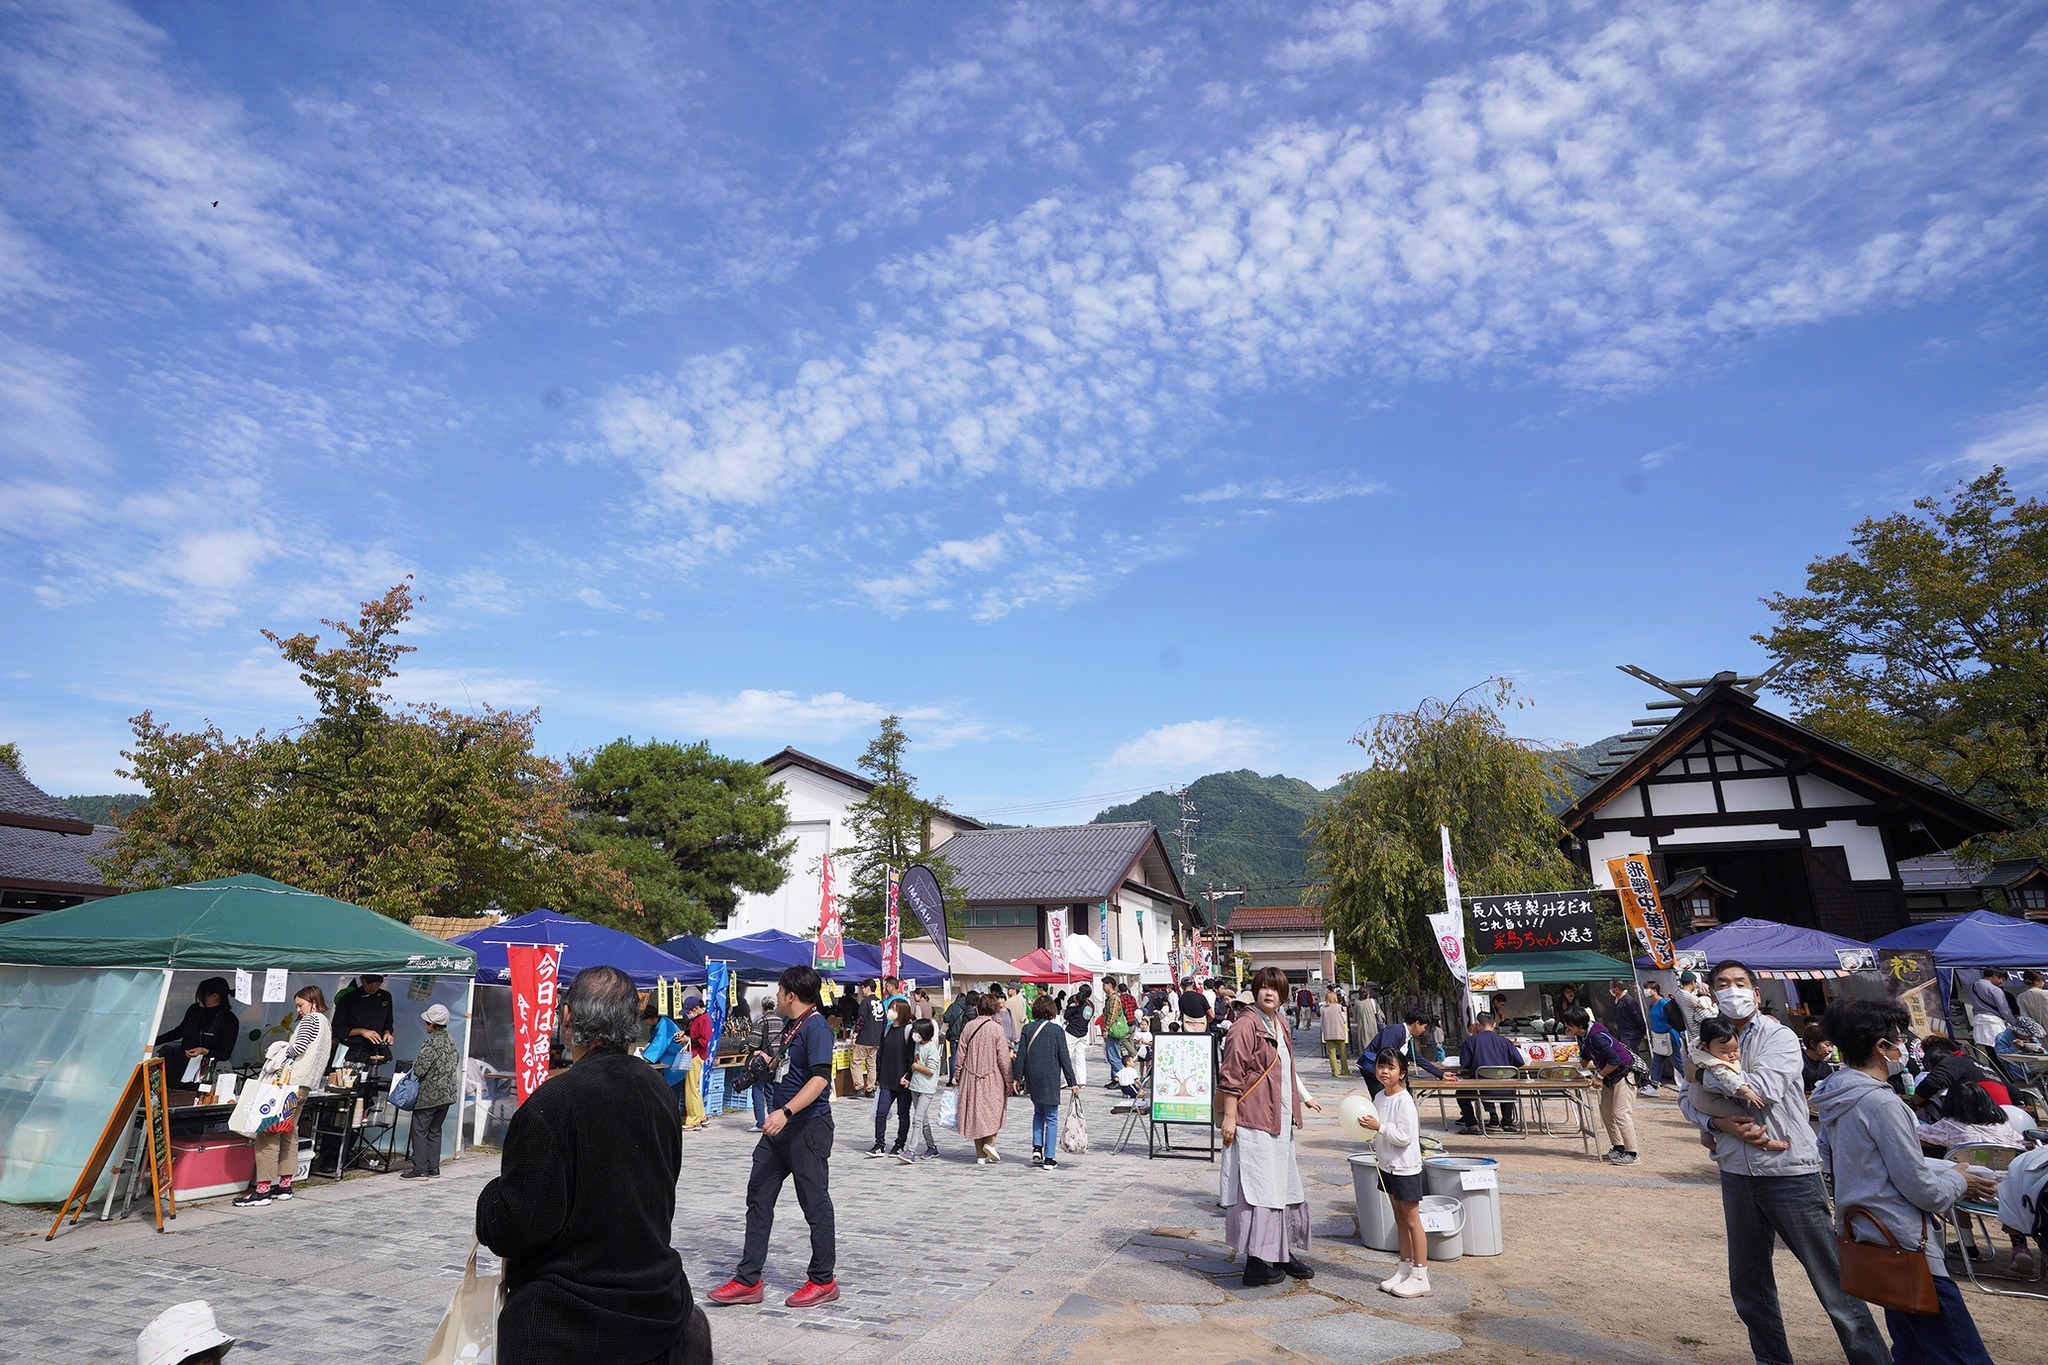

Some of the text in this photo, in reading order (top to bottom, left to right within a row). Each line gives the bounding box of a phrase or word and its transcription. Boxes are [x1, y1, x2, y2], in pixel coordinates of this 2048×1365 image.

[907, 884, 931, 923] IMAYAH
[1472, 898, 1593, 918] 長八特製みそだれ
